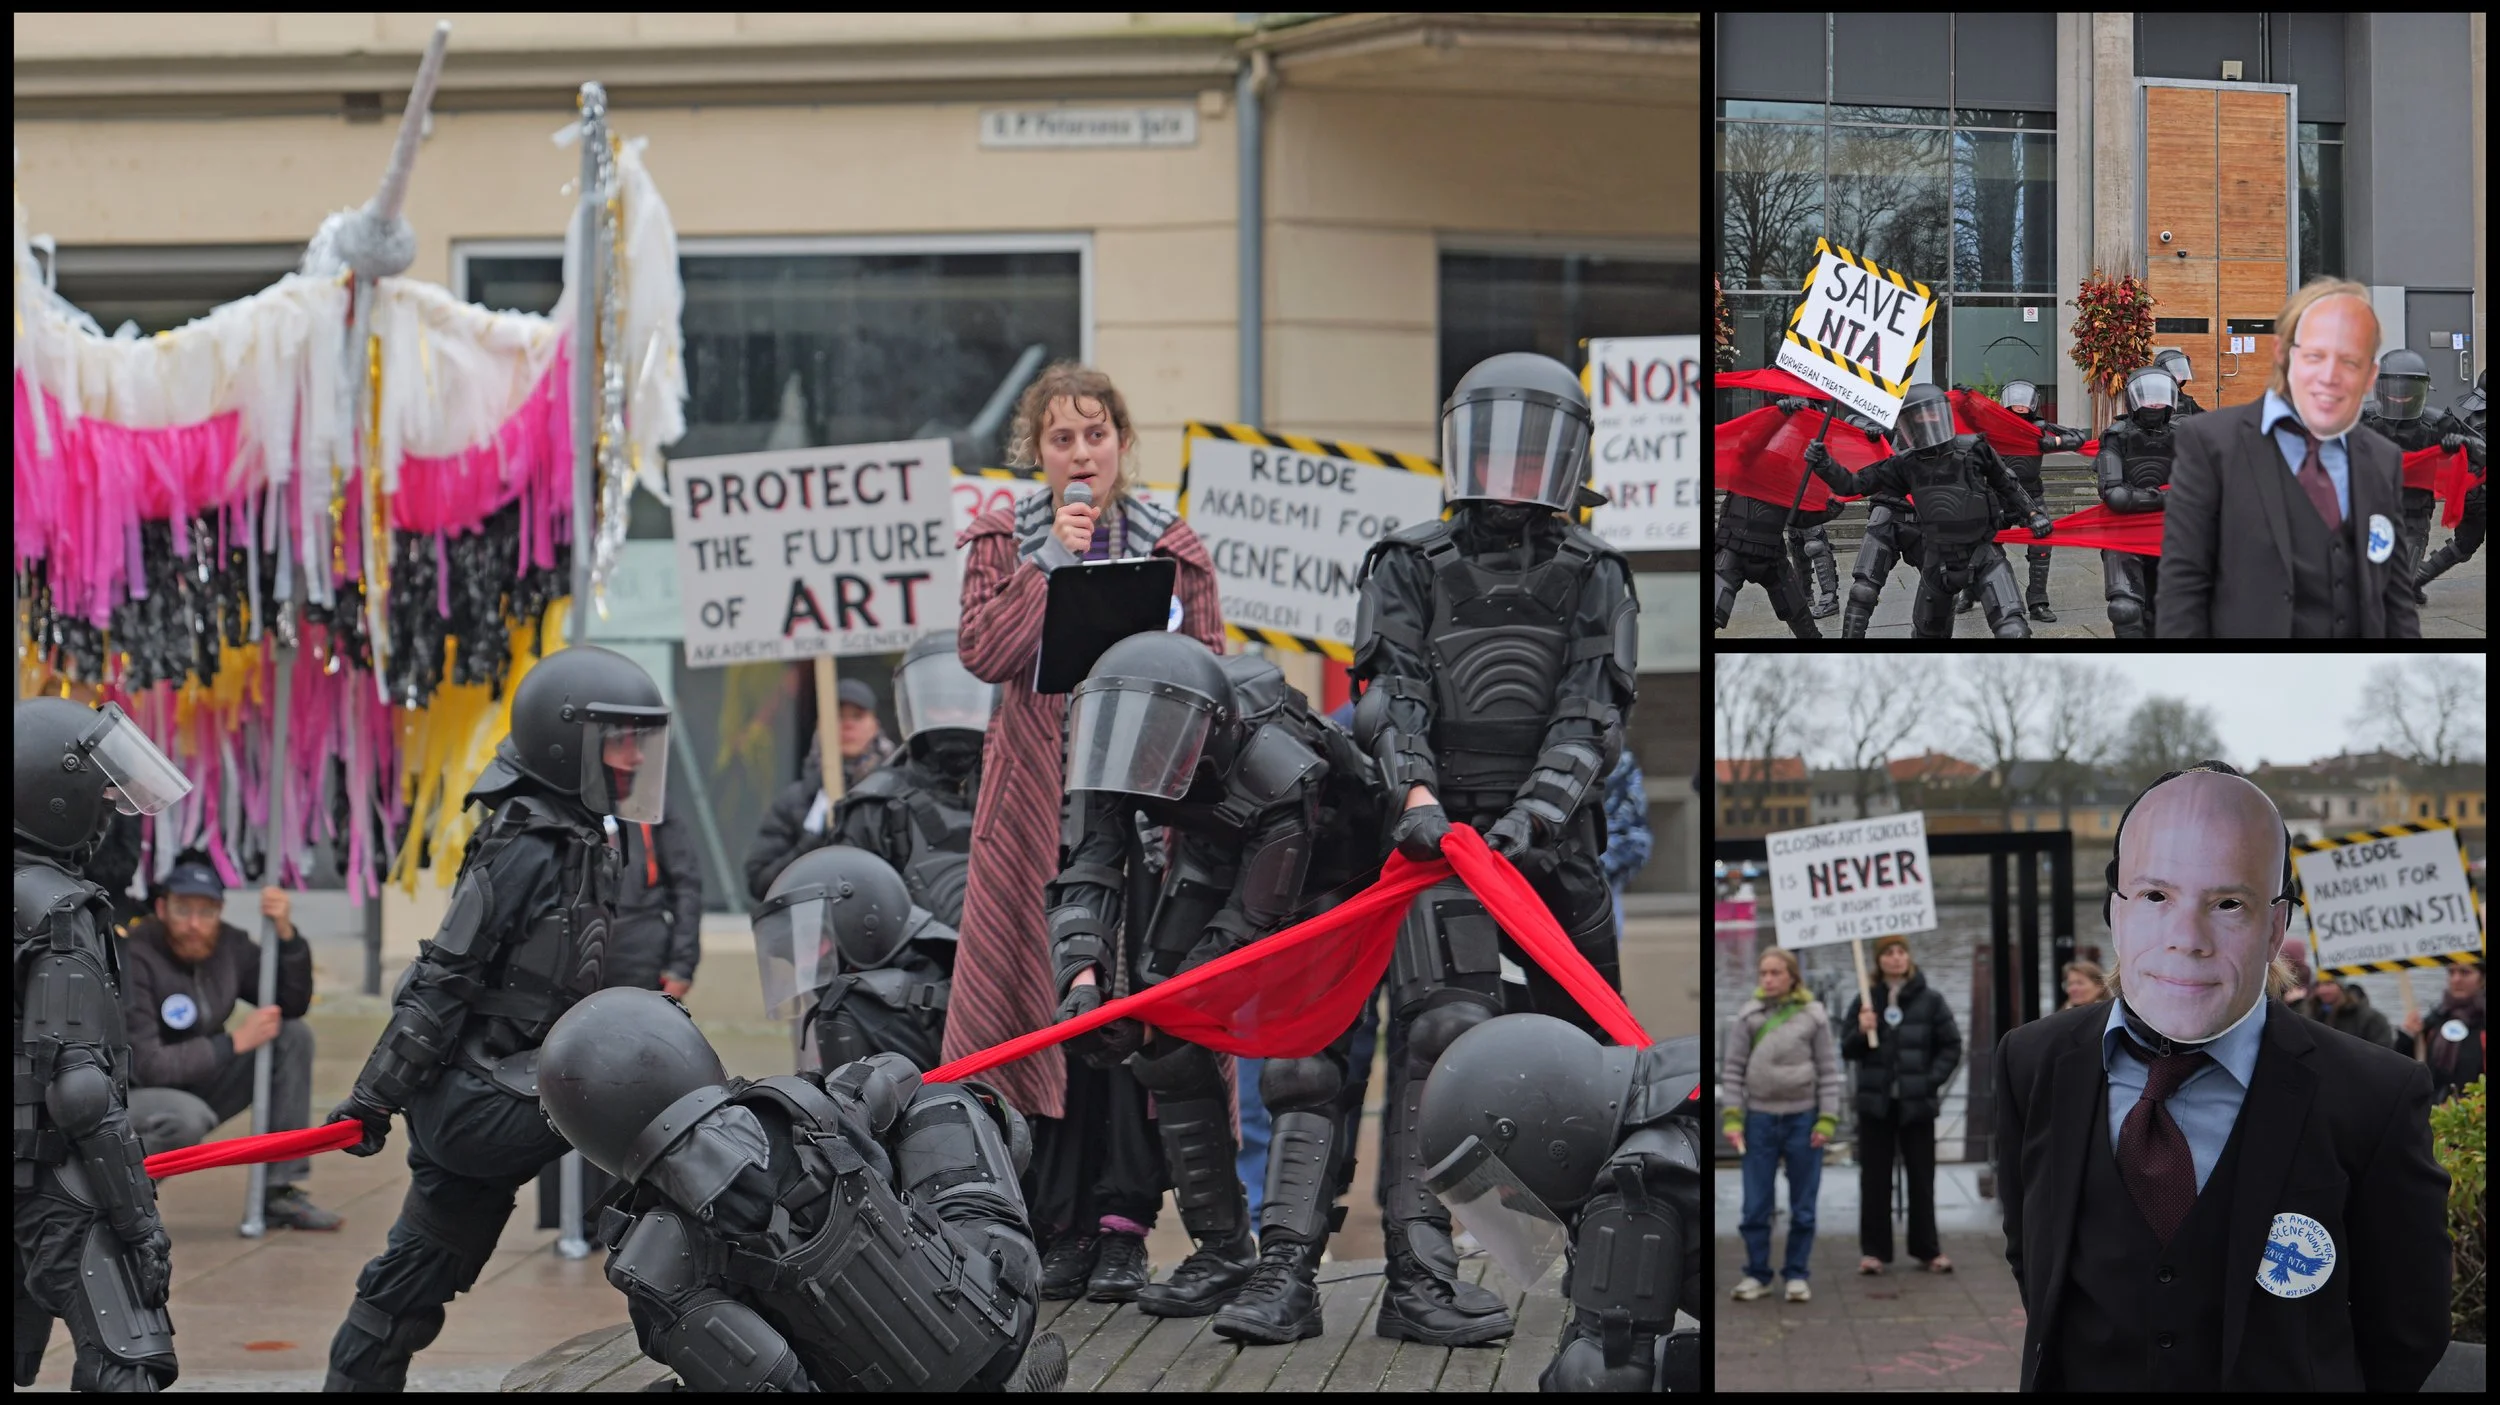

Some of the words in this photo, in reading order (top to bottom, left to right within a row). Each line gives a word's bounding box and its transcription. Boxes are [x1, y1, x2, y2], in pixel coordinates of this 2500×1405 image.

[1825, 262, 1917, 337] SAVE
[1817, 307, 1882, 374] NTA
[1600, 357, 1700, 405] NOR
[1778, 352, 1820, 382] NORWEGIAN
[1821, 376, 1853, 400] THEATRE
[1853, 395, 1890, 421] ACADEMY
[686, 459, 921, 520] PROTECT
[1250, 450, 1357, 494] REDDE
[1600, 481, 1659, 510] ART
[1199, 486, 1321, 531] AKADEMI
[1338, 510, 1403, 541] FOR
[1645, 520, 1690, 542] ELSE
[691, 536, 754, 571] THE
[783, 521, 946, 566] FUTURE
[1200, 533, 1358, 598] CENEKUN
[701, 597, 745, 629] OF
[782, 570, 931, 638] ART
[693, 639, 783, 662] AKADEMI
[1773, 829, 1836, 856] CLOSING
[1838, 827, 1863, 848] ART
[1866, 819, 1920, 844] SCHOOLS
[2331, 841, 2403, 872] REDDE
[1779, 875, 1797, 891] IS
[1806, 850, 1924, 900] NEVER
[2313, 872, 2389, 901] AKADEMI
[2397, 862, 2440, 888] FOR
[1782, 908, 1803, 923] ON
[1810, 904, 1838, 919] THE
[1840, 897, 1882, 914] RIGHT
[1888, 891, 1924, 909] SIDE
[1799, 925, 1819, 941] OF
[1836, 910, 1928, 937] HISTORY
[2264, 1246, 2285, 1261] SAVE
[2288, 1256, 2308, 1272] NTA
[2290, 1214, 2326, 1241] AKADEMI
[2323, 1242, 2334, 1261] FOR
